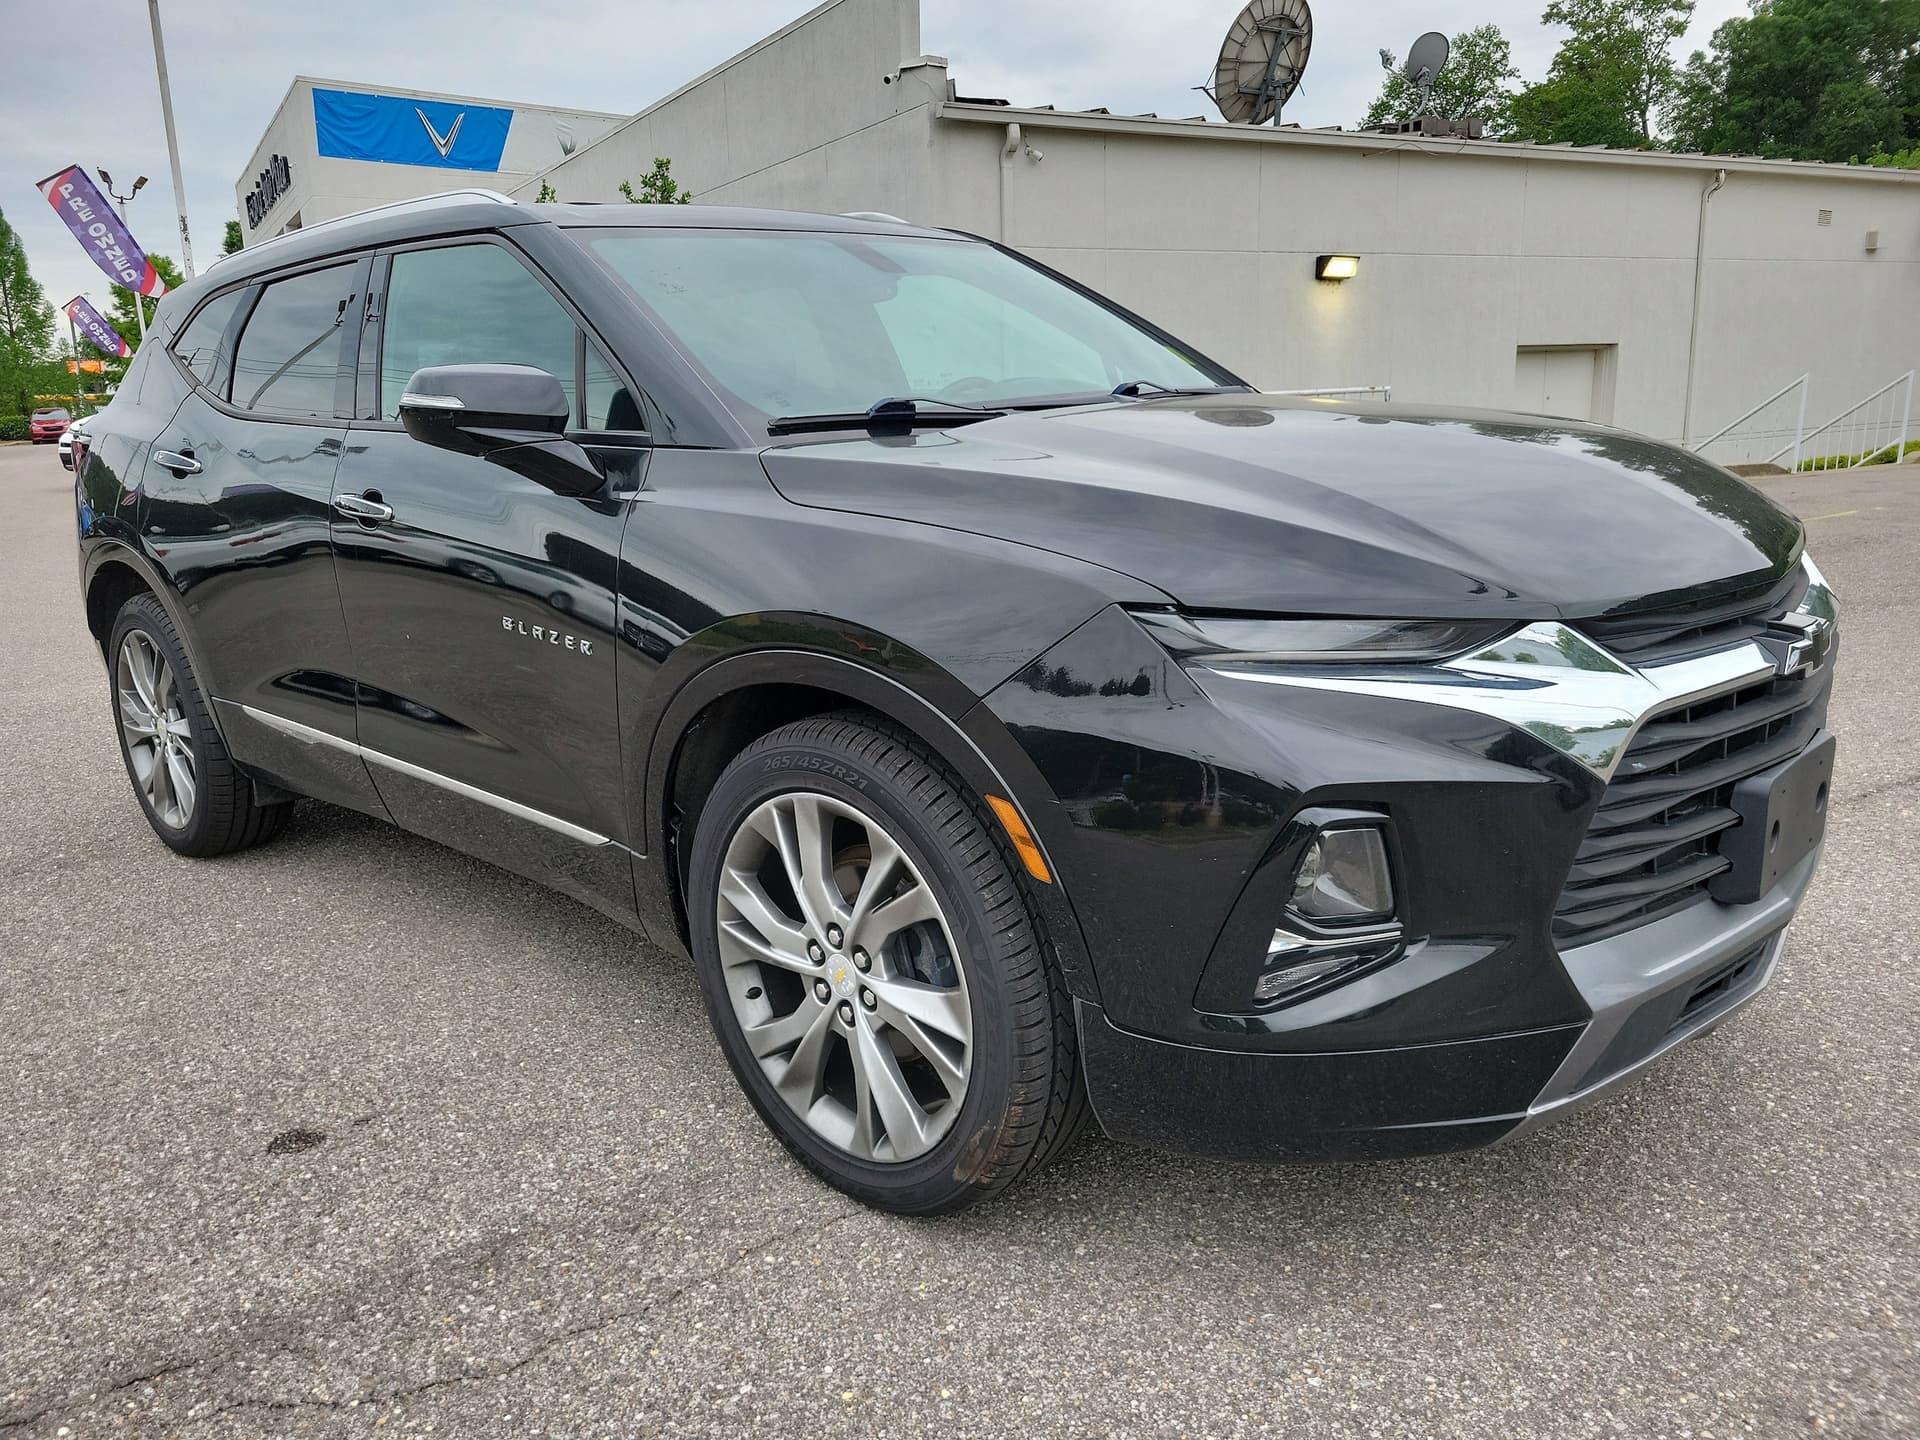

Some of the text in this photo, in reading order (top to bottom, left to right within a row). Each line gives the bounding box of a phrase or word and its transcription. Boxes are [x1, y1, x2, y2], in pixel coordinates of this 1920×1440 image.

[59, 183, 137, 283] PRE OWNED
[72, 305, 117, 352] PRE OWNED
[502, 616, 593, 656] BLAZER
